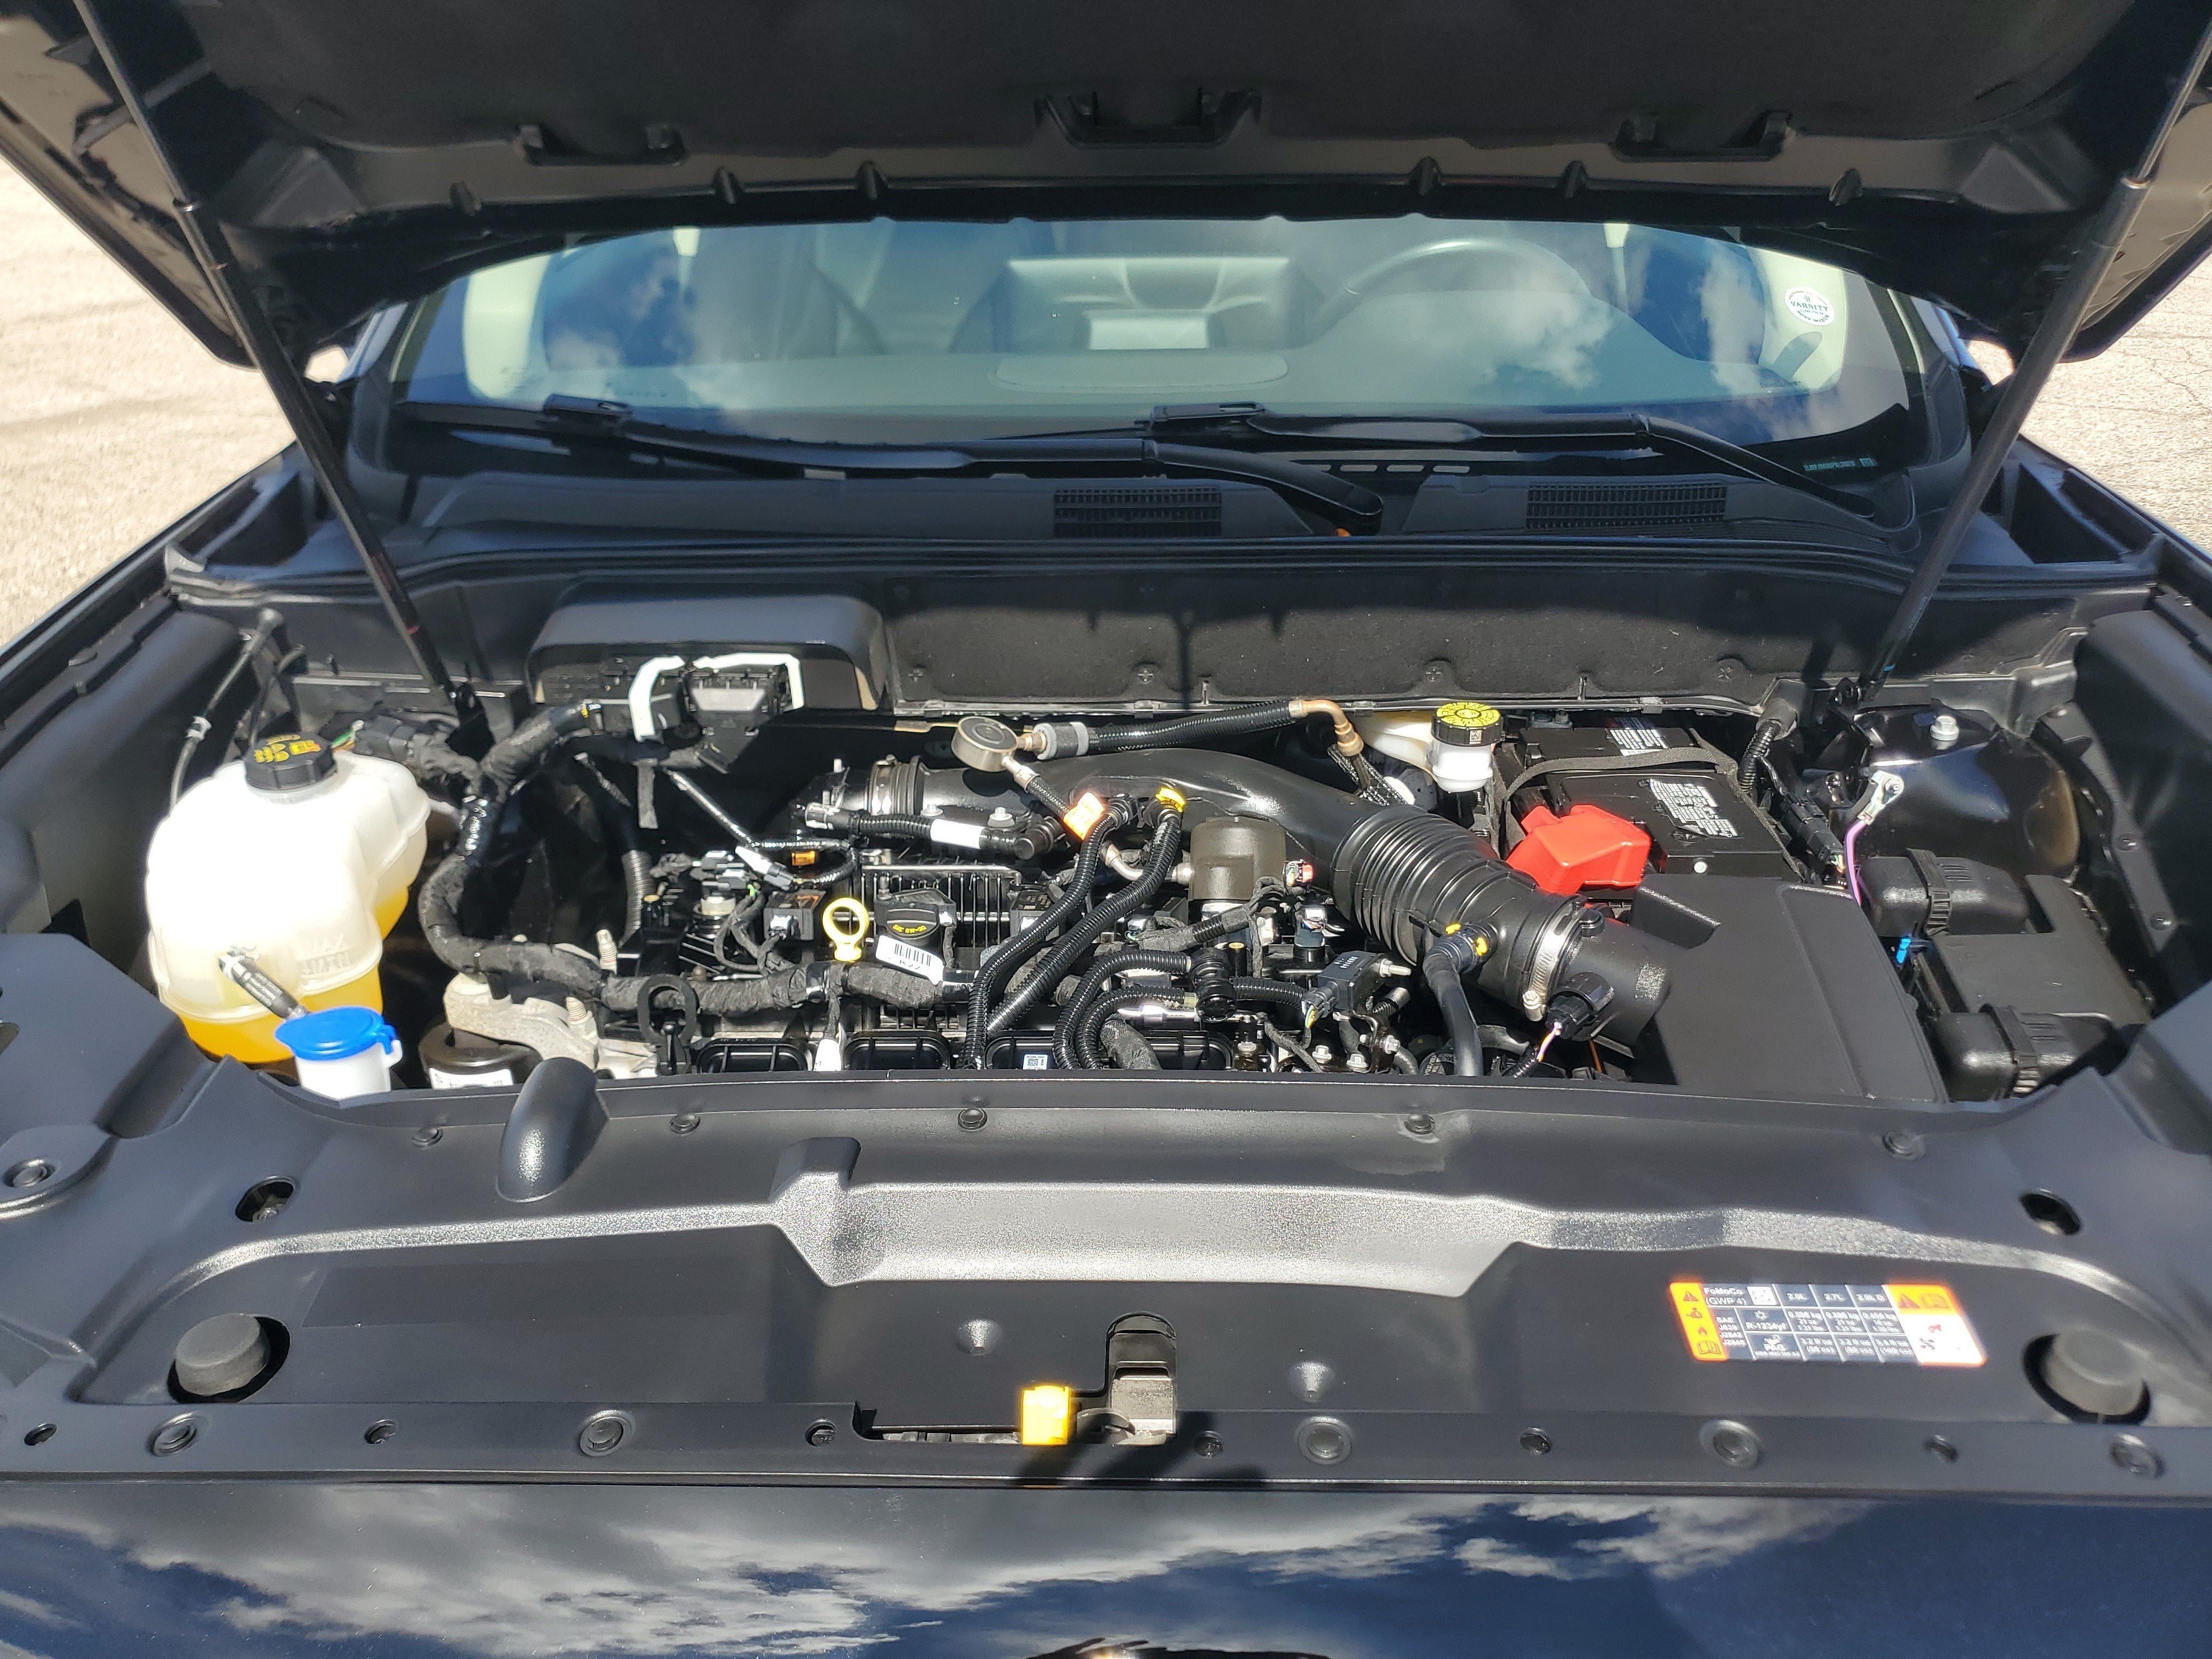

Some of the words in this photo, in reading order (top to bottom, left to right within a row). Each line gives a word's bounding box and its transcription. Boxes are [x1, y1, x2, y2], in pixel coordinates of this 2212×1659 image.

[1790, 301, 1828, 312] VARSITY
[1703, 1286, 1743, 1295] FoMoCo
[1705, 1296, 1734, 1306] (GWP
[1736, 1297, 1747, 1306] 4)
